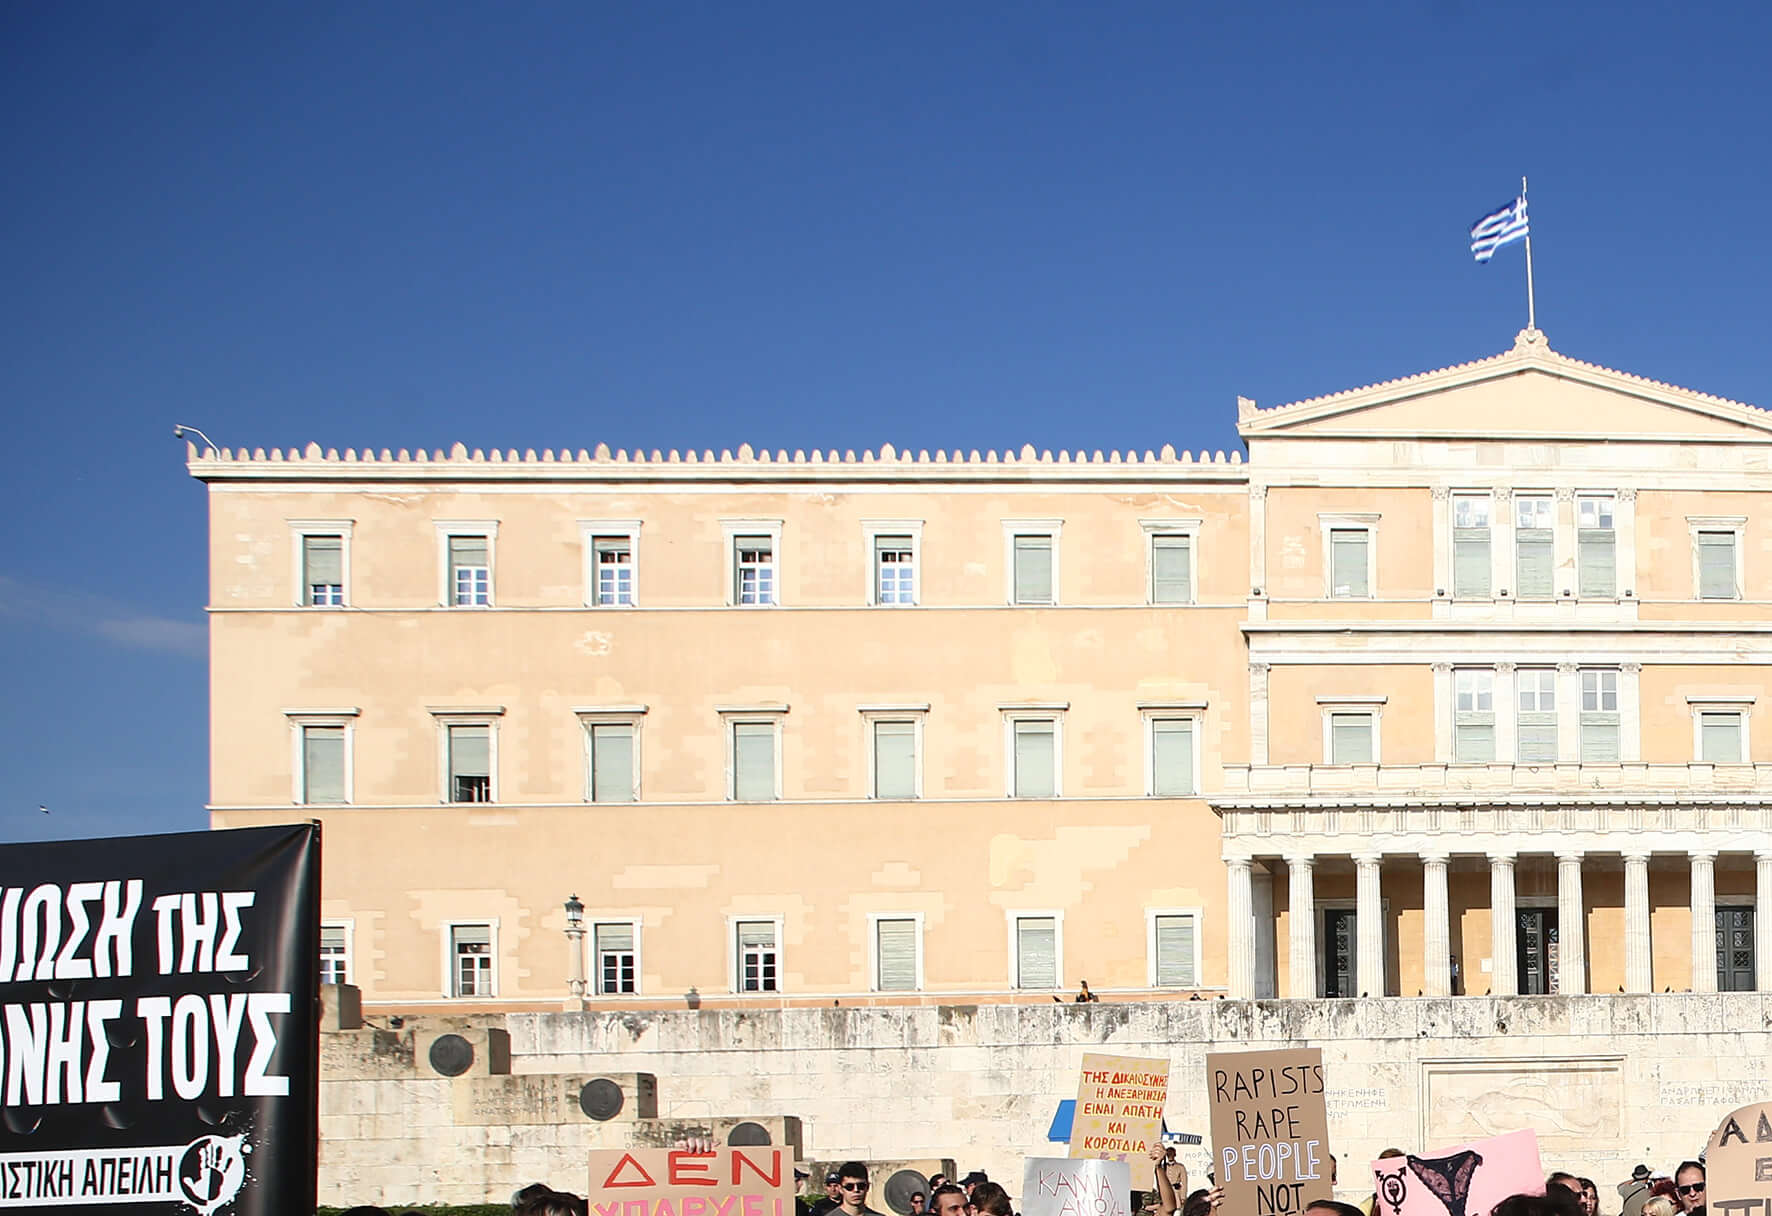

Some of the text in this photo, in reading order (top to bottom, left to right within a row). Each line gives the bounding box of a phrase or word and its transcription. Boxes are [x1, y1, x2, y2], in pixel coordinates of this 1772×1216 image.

[0, 879, 255, 982] ΩΣΗ ΤΗΣ
[0, 993, 291, 1106] ΝΗΣ ΤΟΥΣ
[1083, 1071, 1168, 1088] ΤΗΣ ΔΙΚΑΙΟΣΥΝΗΣ
[1096, 1087, 1104, 1098] Η
[1215, 1065, 1324, 1103] RAPISTS
[1084, 1103, 1162, 1119] ΕΙΝΑΙ ΑΠΑΤΗ
[1108, 1121, 1127, 1134] ΚΑΙ
[1236, 1106, 1301, 1141] RAPE
[0, 1155, 173, 1199] ΙΣΤΙΚΗ ΑΠΕΙΛΗ
[603, 1150, 780, 1188] ΔΕΝ
[1222, 1140, 1320, 1182] PEOPLE
[1257, 1183, 1304, 1215] NOT
